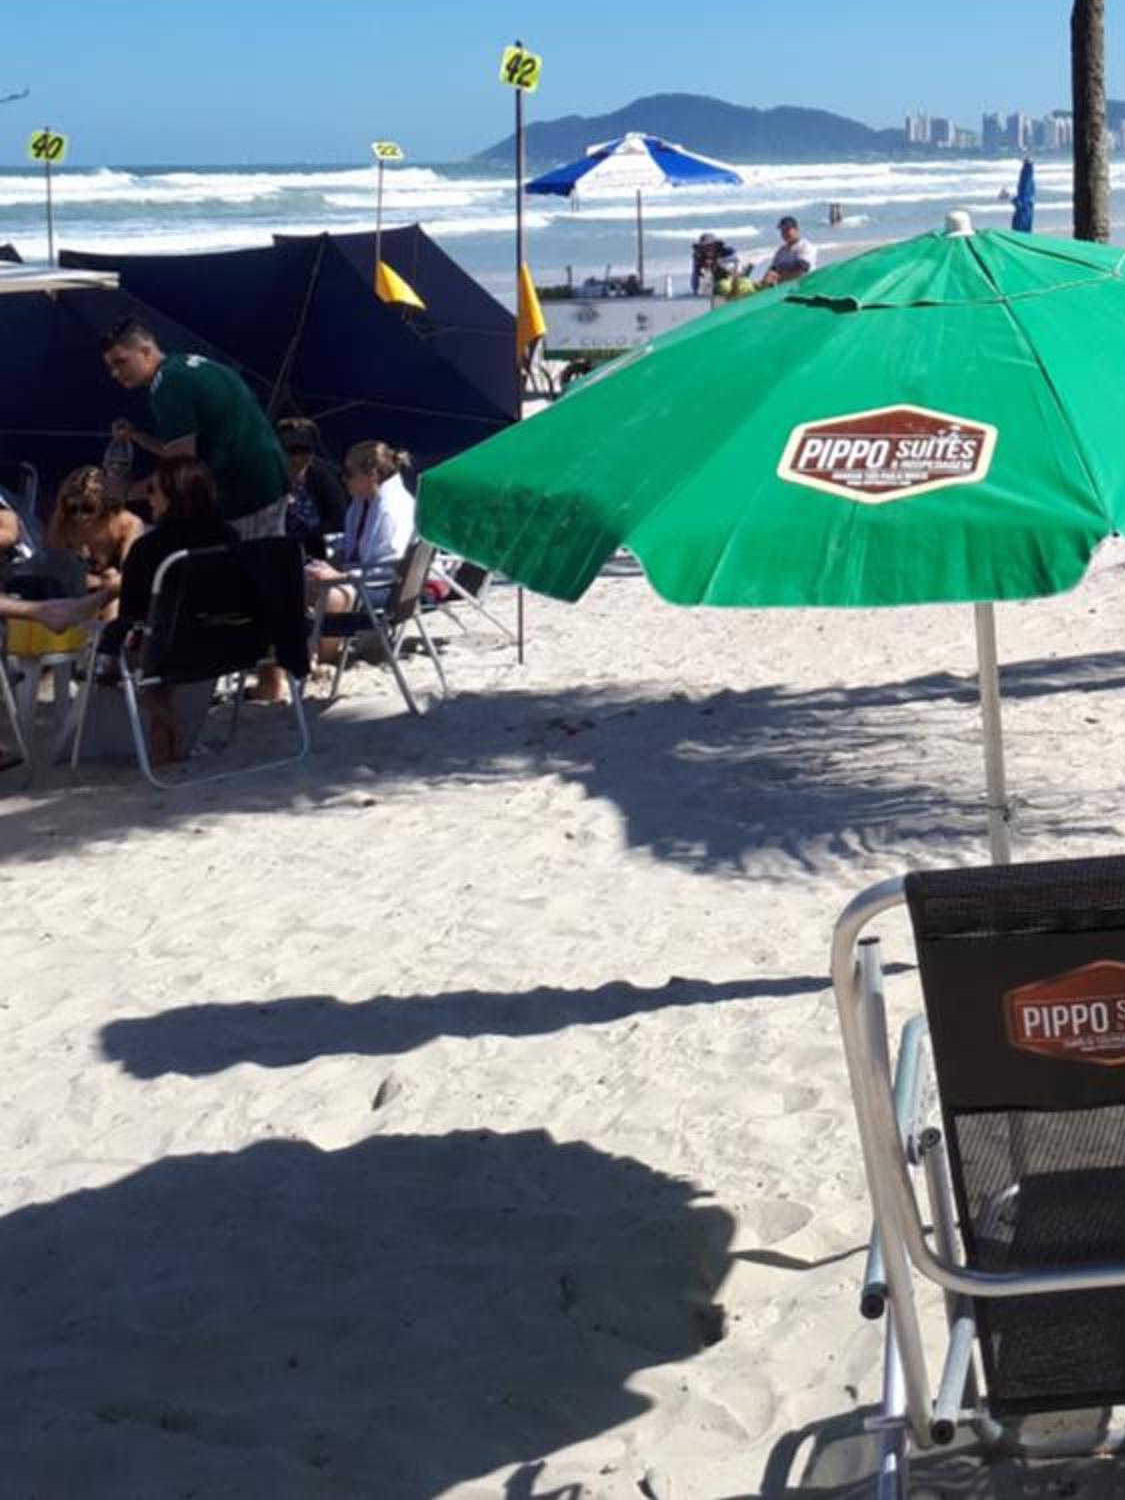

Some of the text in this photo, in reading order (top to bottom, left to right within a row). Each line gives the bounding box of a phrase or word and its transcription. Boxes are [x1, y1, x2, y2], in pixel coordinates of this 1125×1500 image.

[505, 53, 537, 88] 42
[32, 133, 64, 159] 40
[797, 437, 891, 470] PIPPO
[1022, 1001, 1110, 1039] PIPPO
